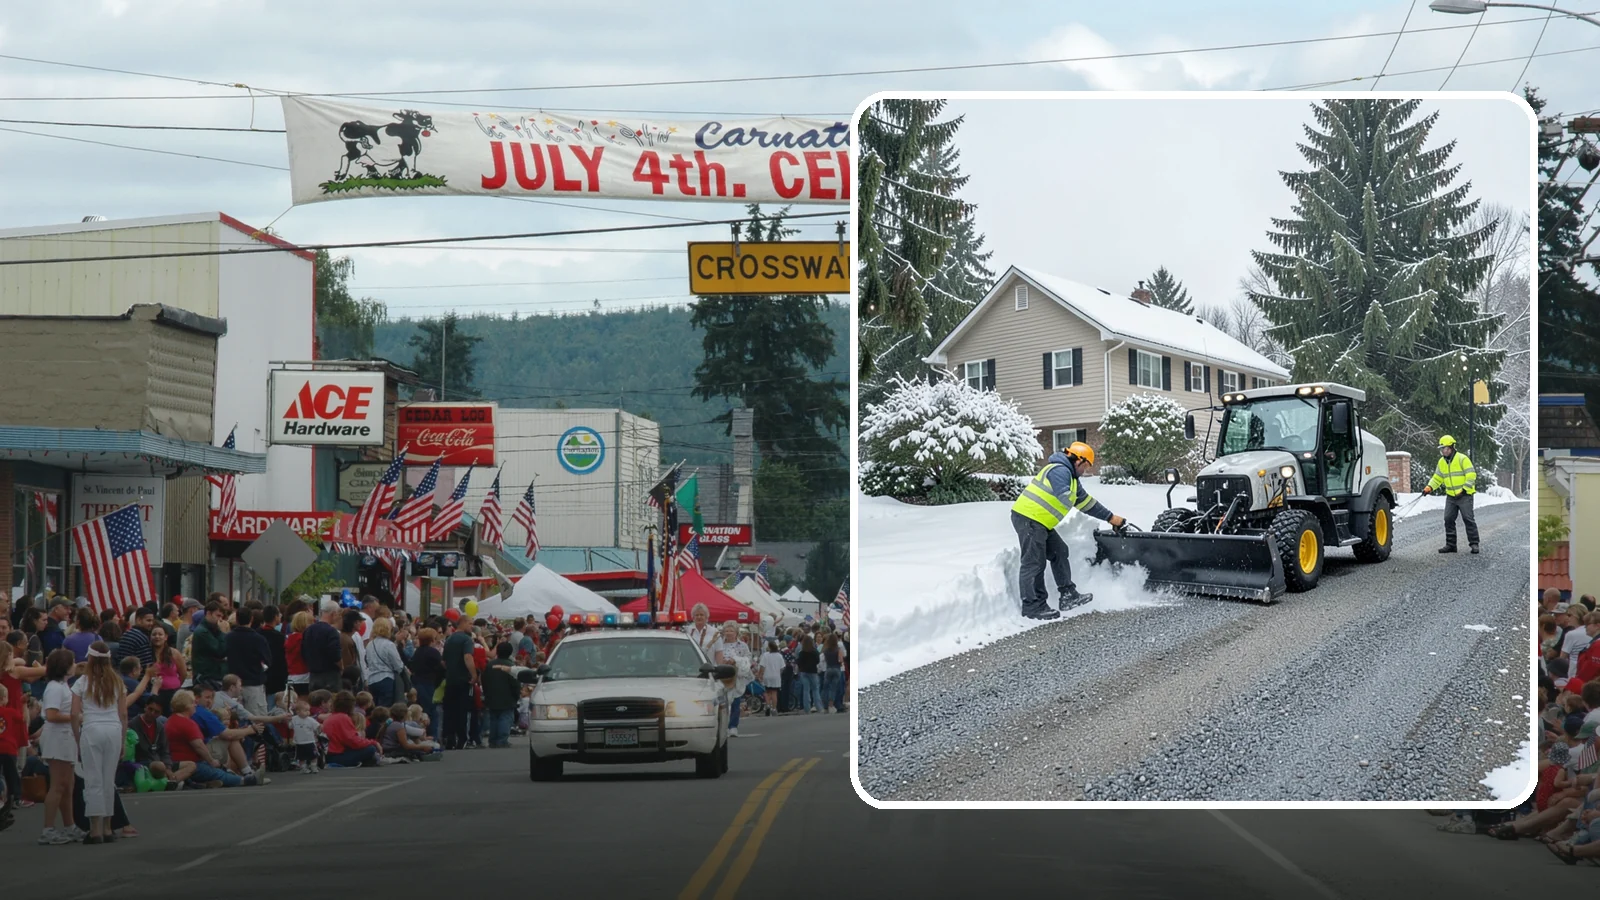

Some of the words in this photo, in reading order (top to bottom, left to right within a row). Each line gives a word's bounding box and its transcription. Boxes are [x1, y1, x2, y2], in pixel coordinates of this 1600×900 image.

[695, 121, 850, 149] Carnat
[481, 141, 605, 192] JULY
[632, 150, 746, 198] 4th.
[696, 254, 850, 280] CROSSWA
[282, 380, 373, 420] ACE
[405, 409, 452, 422] CEDAR
[461, 409, 485, 421] LOG
[283, 421, 371, 436] Hardware
[353, 467, 385, 479] Simpl
[95, 485, 124, 495] Vincent
[126, 486, 135, 495] de
[137, 486, 155, 495] Paul
[688, 527, 741, 535] CRNATION
[699, 535, 730, 543] GLASS
